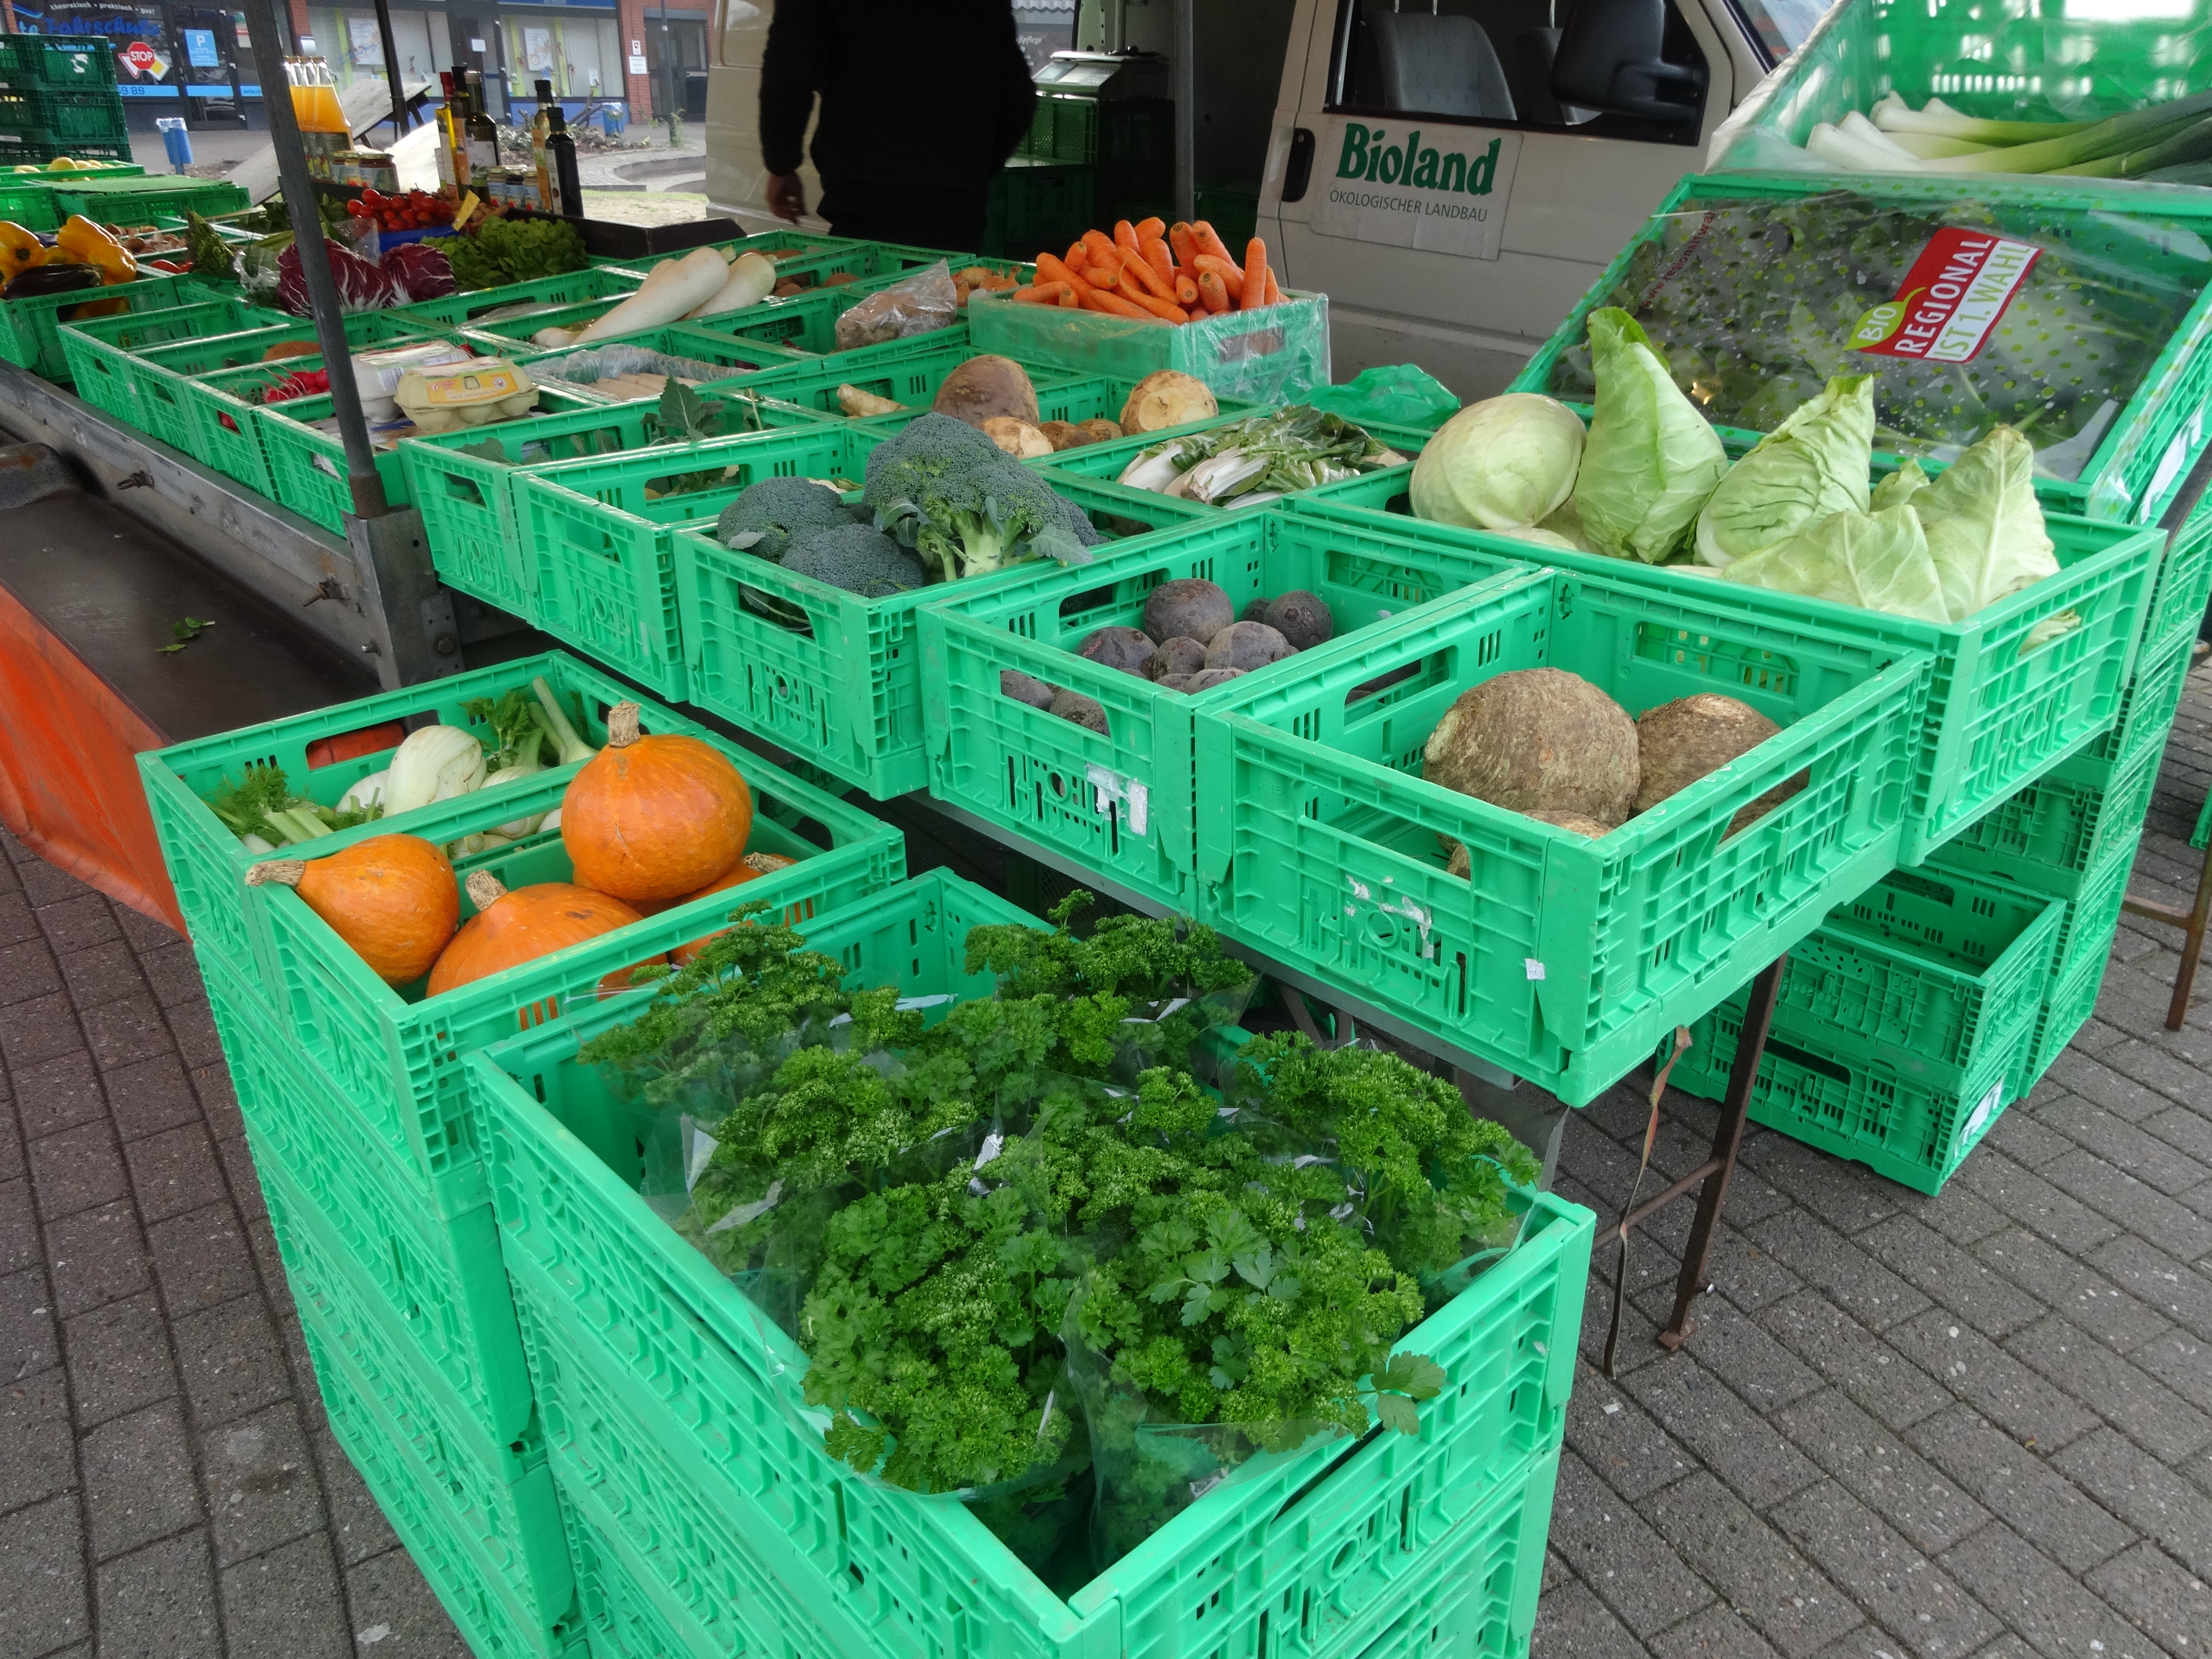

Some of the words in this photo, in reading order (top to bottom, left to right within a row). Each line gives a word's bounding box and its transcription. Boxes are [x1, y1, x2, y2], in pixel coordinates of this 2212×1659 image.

[50, 2, 91, 10] theoretisch
[196, 35, 206, 47] P
[130, 51, 153, 62] STOP
[131, 86, 145, 94] 89
[1336, 123, 1501, 195] Bioland
[1330, 187, 1422, 214] ÖKOLOGISCHER
[1425, 202, 1488, 222] LANDBAU
[1967, 246, 2031, 303] WAHL
[1894, 239, 1992, 354] REGIONAL
[1857, 306, 1897, 342] BIO
[1959, 310, 1992, 321] 1.
[1932, 326, 1977, 358] IST
[432, 383, 438, 391] 6
